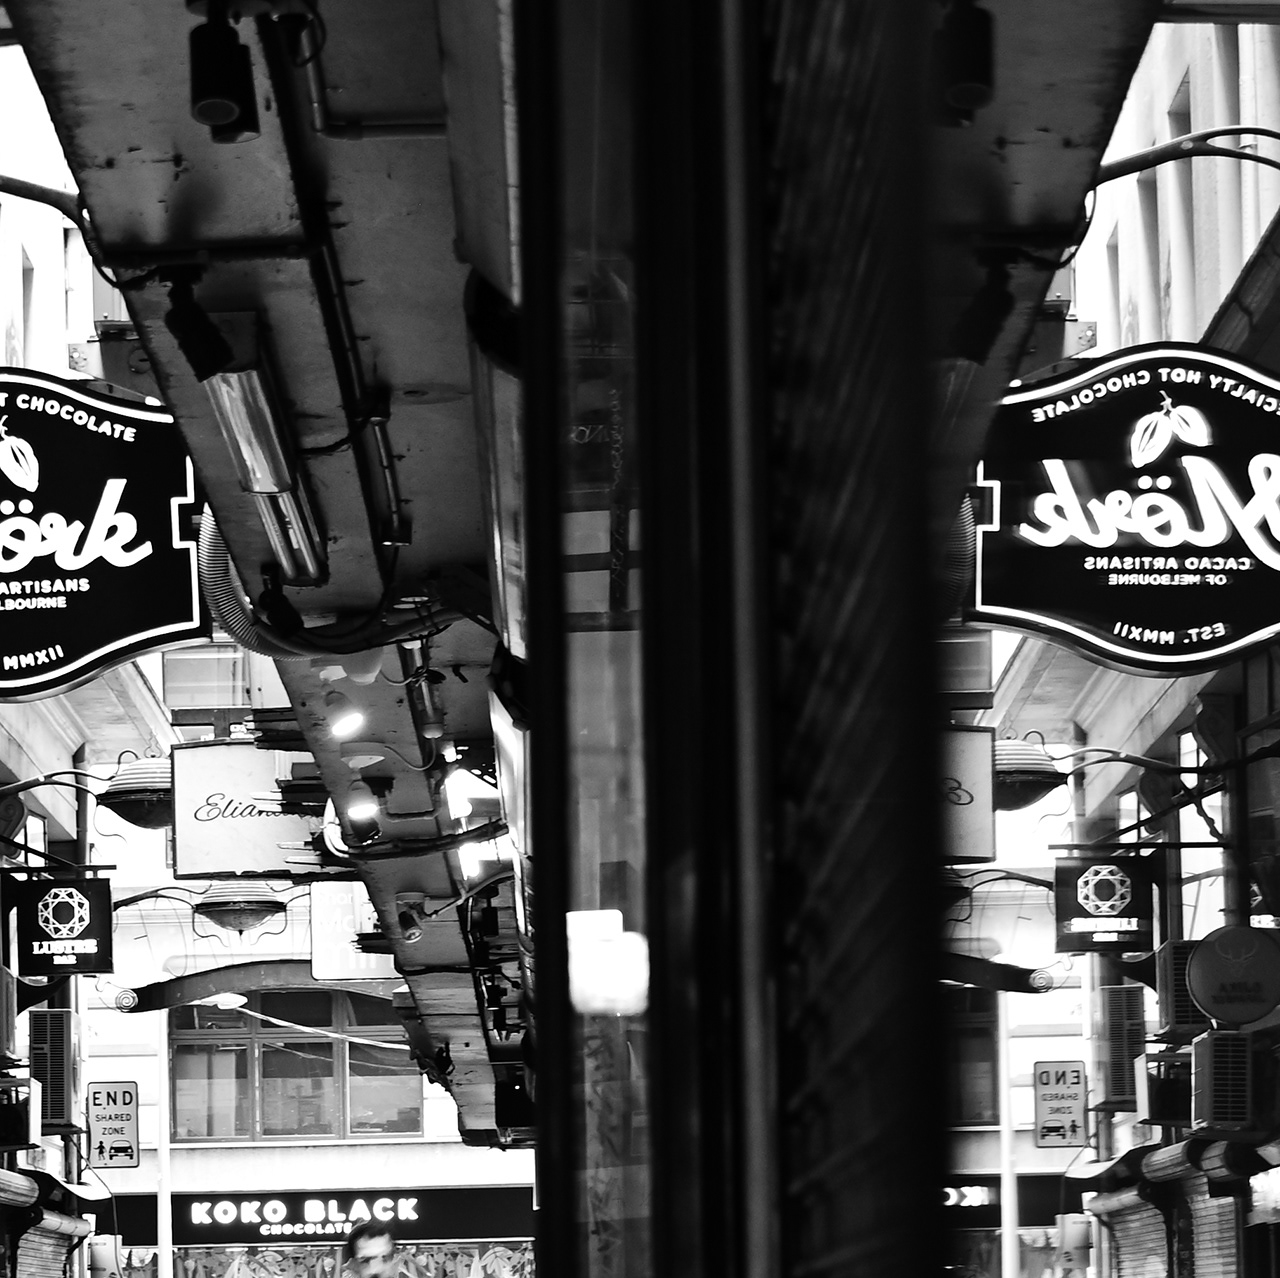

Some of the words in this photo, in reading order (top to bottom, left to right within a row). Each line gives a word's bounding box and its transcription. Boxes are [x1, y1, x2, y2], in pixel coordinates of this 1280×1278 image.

[16, 394, 137, 443] CHOCOLATE
[3, 644, 64, 670] MMXII
[93, 1091, 134, 1106] END
[95, 1113, 132, 1122] SHARED
[102, 1127, 126, 1136] ZONE
[190, 1200, 287, 1224] KOKO
[303, 1197, 419, 1223] BLACK
[259, 1222, 352, 1235] CHOCOLATE
